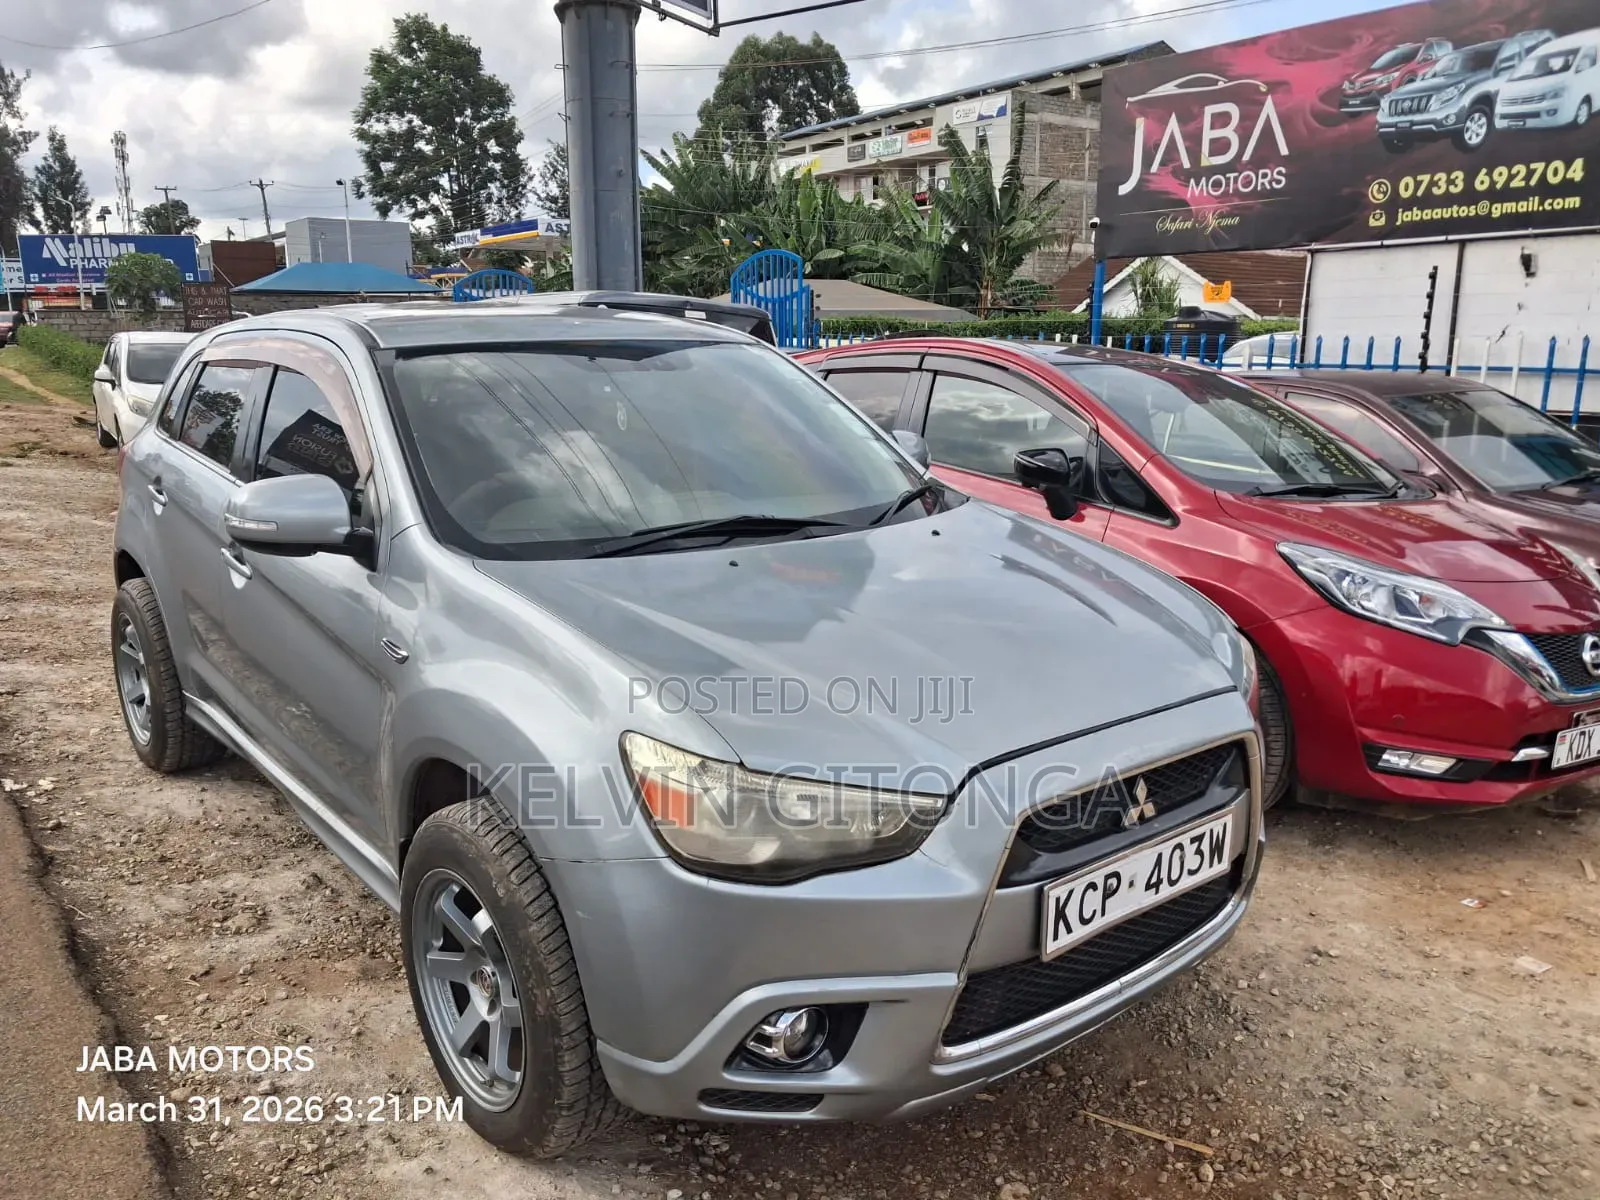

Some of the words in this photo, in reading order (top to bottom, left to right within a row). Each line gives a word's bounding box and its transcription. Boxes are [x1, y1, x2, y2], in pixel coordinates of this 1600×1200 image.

[1118, 95, 1289, 196] JABA
[1187, 167, 1286, 198] MOTORS
[1398, 170, 1465, 199] 0733
[1474, 157, 1584, 191] 692704
[1156, 215, 1194, 235] Safari
[1196, 209, 1240, 235] Njema
[1396, 196, 1581, 225] jabaautos@gmail.com
[42, 237, 136, 266] Malibu
[1566, 729, 1596, 762] KDX
[1053, 869, 1122, 943] KCP
[1144, 822, 1227, 896] 403W
